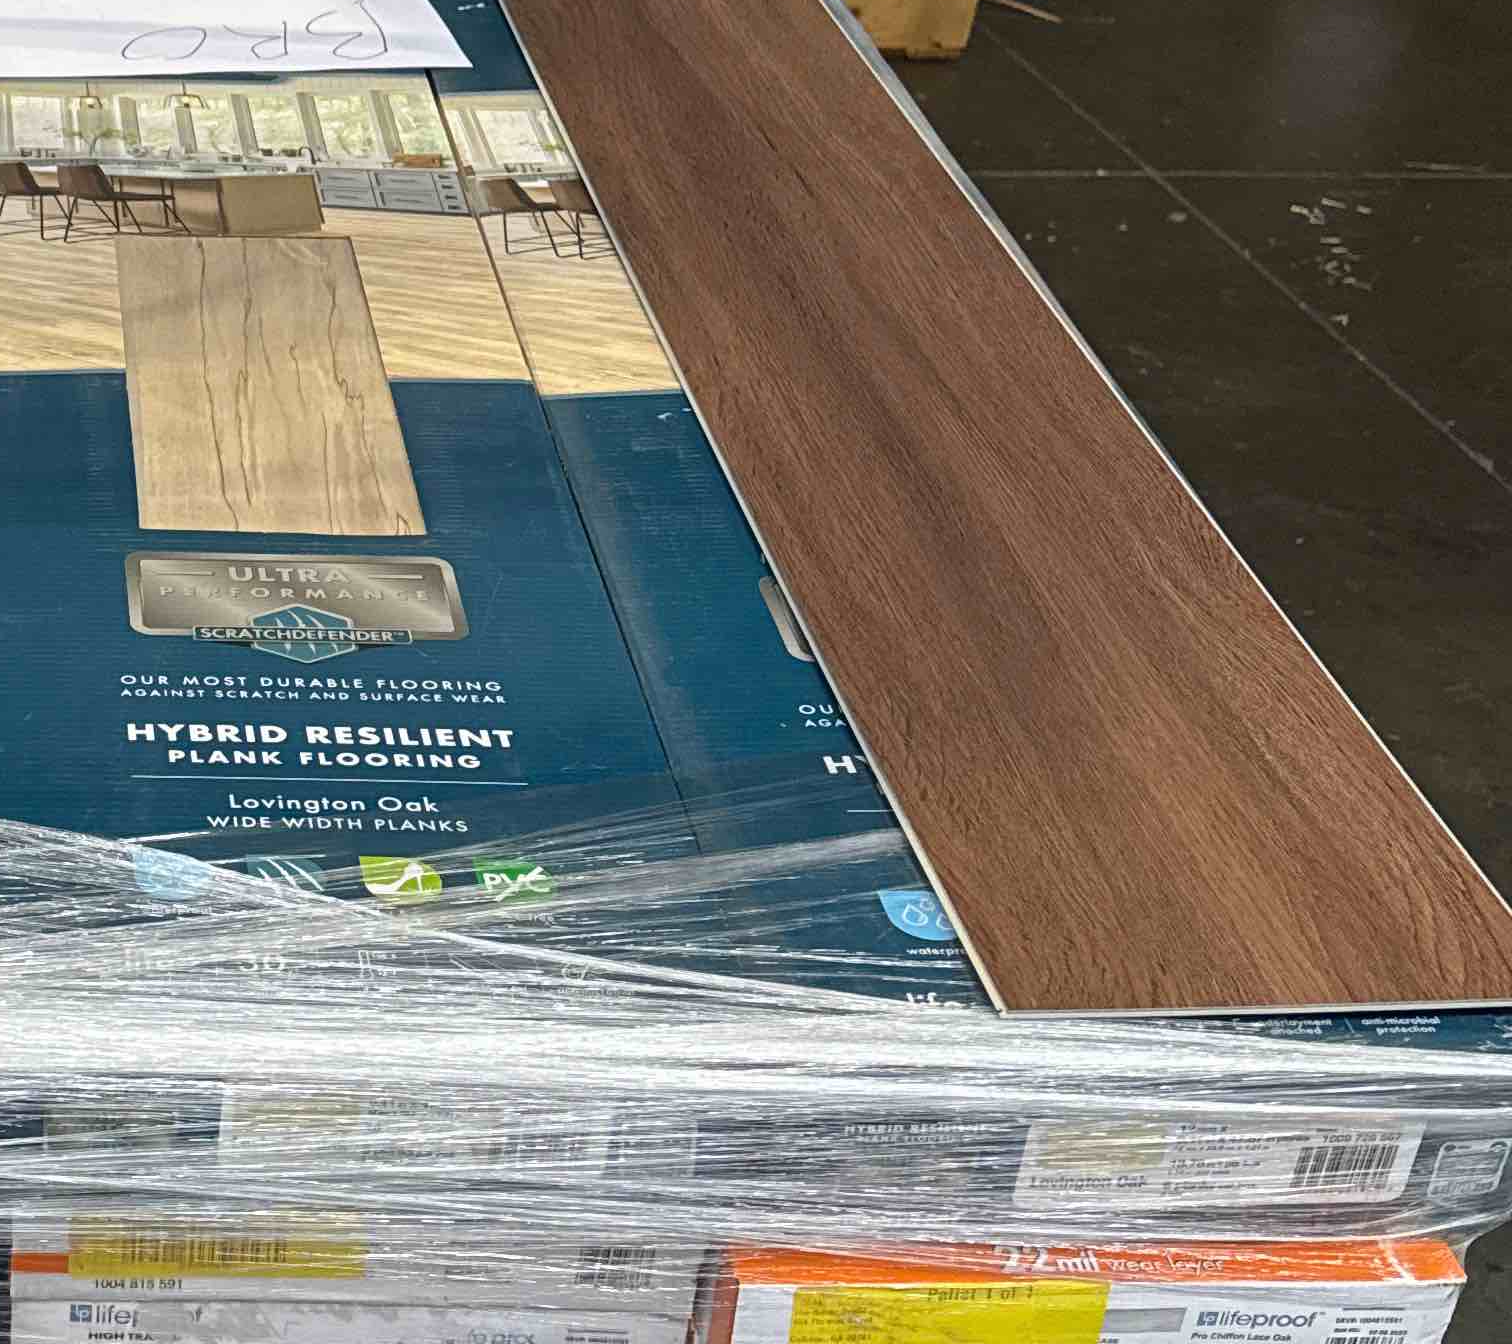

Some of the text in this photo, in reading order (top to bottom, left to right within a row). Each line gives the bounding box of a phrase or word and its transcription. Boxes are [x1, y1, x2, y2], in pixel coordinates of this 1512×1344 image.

[226, 566, 351, 583] ULTRA
[120, 674, 503, 693] OUR MOST DURABLE FLOORING
[120, 688, 507, 705] AGAINST SCRATCH AND SURFACE WEAR
[798, 704, 835, 716] OU
[126, 722, 515, 750] HYBRID RESILIENT
[167, 748, 483, 770] PLANK FLOORING
[228, 793, 440, 815] Lovington Oak
[205, 815, 469, 833] WIDE WIDTH PLANKS
[1054, 1249, 1102, 1273] mil
[1104, 1257, 1162, 1273] wear
[1217, 1309, 1320, 1331] lifeproof
